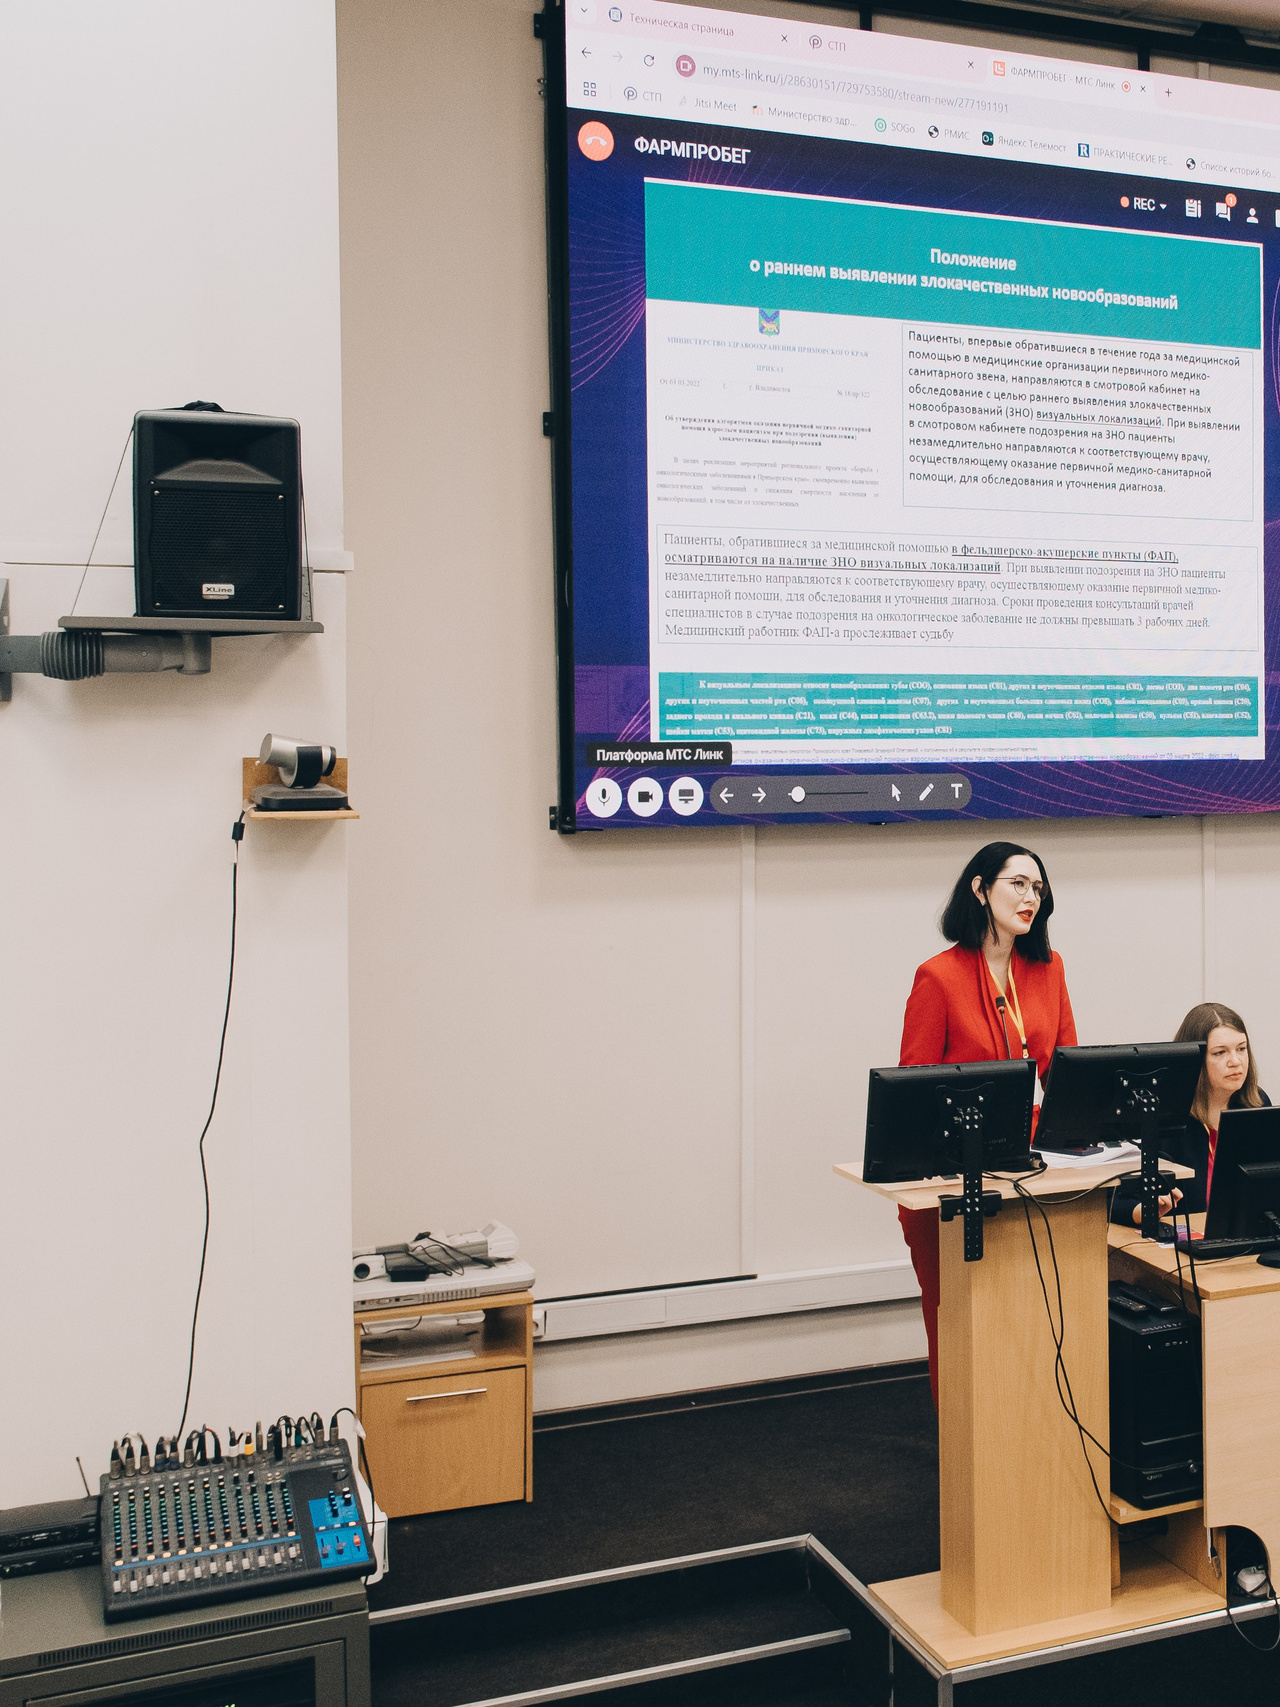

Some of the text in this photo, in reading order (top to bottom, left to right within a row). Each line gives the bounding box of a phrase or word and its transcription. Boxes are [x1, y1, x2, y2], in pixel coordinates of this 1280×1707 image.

[630, 13, 734, 37] Техническая страница
[828, 40, 846, 52] СТП
[1010, 66, 1116, 90] ФАРМПРОБЕГ МТС Линк
[643, 92, 662, 102] СТП
[695, 98, 737, 112] Jitsi Meet
[768, 106, 832, 124] Министерство
[891, 122, 916, 134] SOGo
[944, 129, 970, 140] РМИС
[634, 136, 751, 164] ФАРМПРОБЕГ
[998, 136, 1066, 152] Яндекс Телемост
[1094, 147, 1156, 164] ПРАКТИЧЕСКИЕ
[1200, 161, 1228, 174] Список
[1228, 166, 1260, 178] историй
[1134, 196, 1156, 212] REC
[930, 248, 1017, 271] Положение
[750, 260, 1179, 310] о раннем выявлении злокачественных новообразований
[908, 330, 1240, 367] Пациенты, впервые обратившиеся в течение года за медицинской
[908, 350, 1210, 381] помощью в медицинские организации первичного медико-
[908, 368, 1201, 396] санитарного звена, направляются в смотровой кабинет на
[908, 383, 1212, 414] обследование с целью раннего выявления злокачественных
[908, 401, 1242, 431] новообразований (ЗНО) визуальных локализаций. При выявлении
[908, 420, 1176, 444] в смотровом кабинете подозрения на ЗНО пациенты
[908, 438, 1211, 464] незамедлительно направляются к соответствующему врачу,
[908, 454, 1212, 479] осуществляющему оказание первичной медико-санитарной
[908, 472, 957, 484] помощи,
[958, 475, 979, 485] для
[980, 473, 1054, 488] обследования
[1064, 480, 1117, 490] уточнения
[1118, 483, 1166, 493] диагноза.
[664, 533, 1180, 563] Пациенты, обратившиеся за медицинской помощью в фельдшерско-акушерские пункты (ФАП),
[664, 553, 1226, 579] осматриваются на наличие ЗНО визуальных локализаций. При выявлении подозрения на ЗНО пациенты
[664, 572, 1222, 596] незамедлительно направляются к соответствующему врачу, осуществляющему оказание первичной медико-
[665, 624, 955, 642] Медицинский работник ФАП-а прослеживает судьбу
[596, 748, 662, 764] Платформа
[666, 750, 692, 761] МТС
[694, 749, 724, 760] Линк
